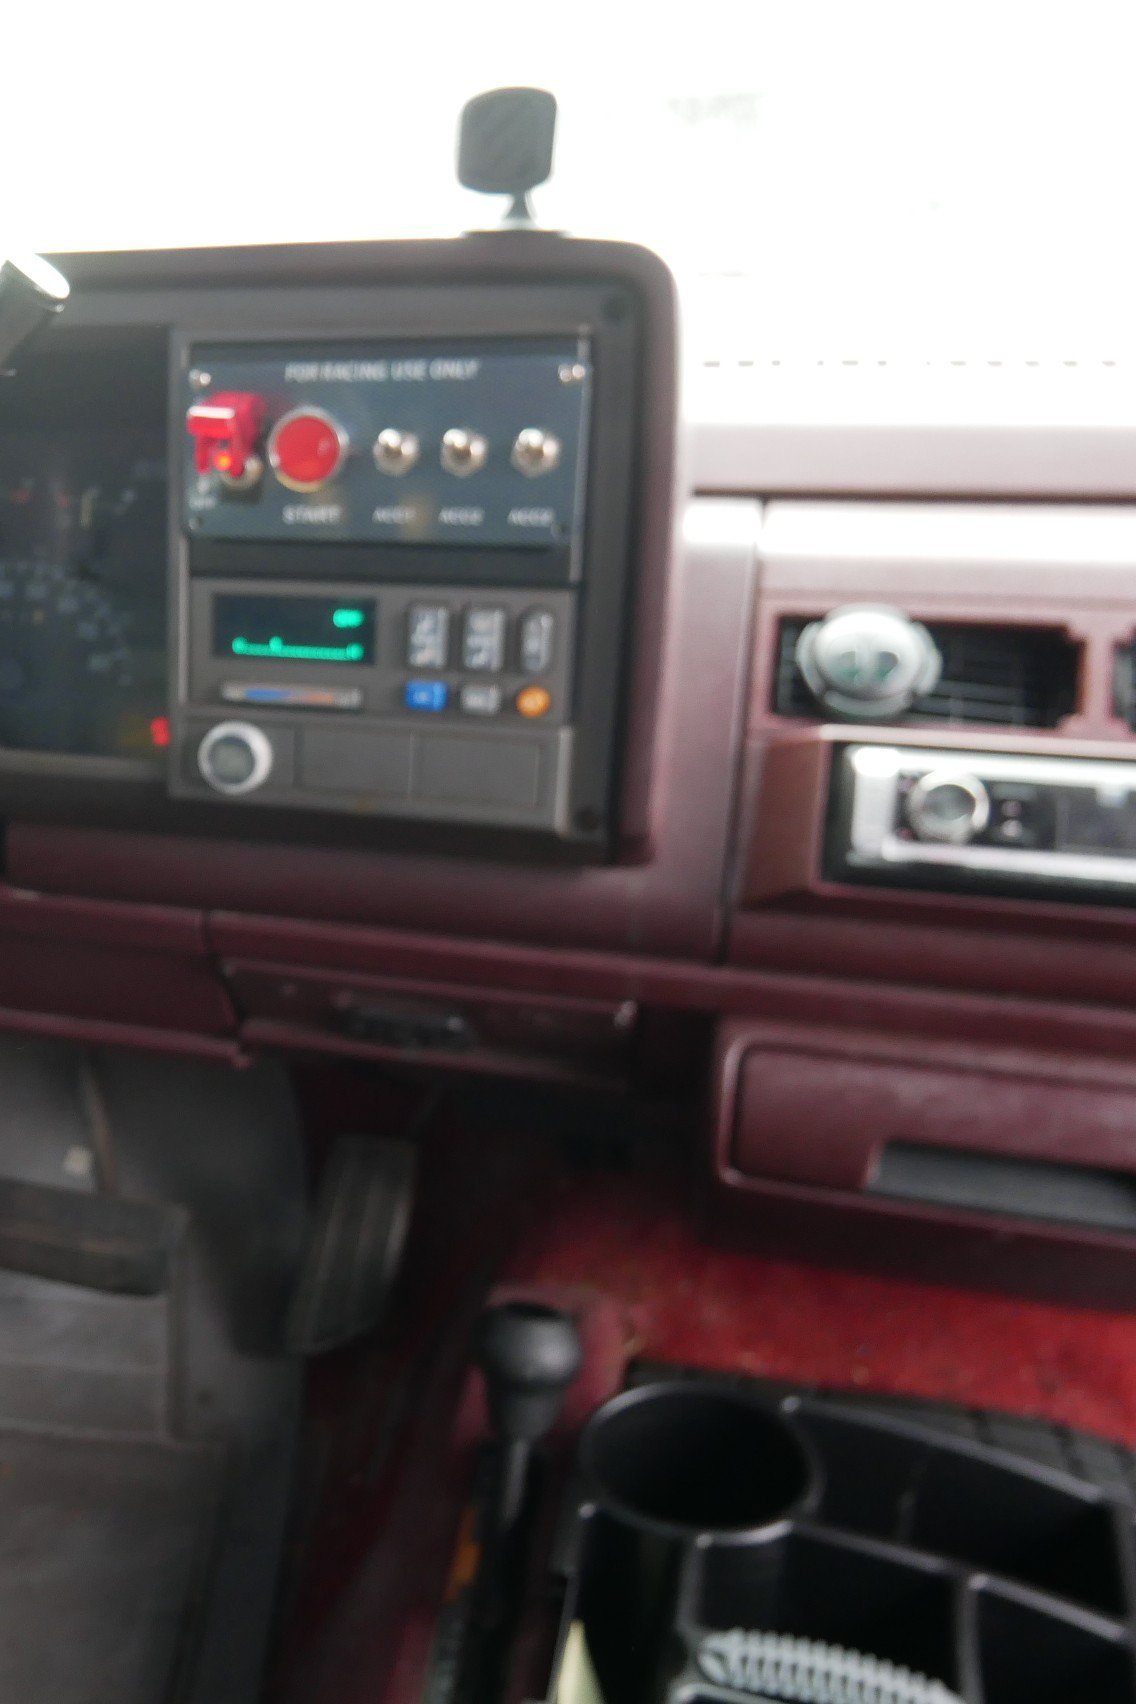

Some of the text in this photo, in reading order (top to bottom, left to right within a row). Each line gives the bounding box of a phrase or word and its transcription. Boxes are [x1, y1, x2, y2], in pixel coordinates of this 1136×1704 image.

[284, 357, 481, 382] FOR RACING USE ONLY
[282, 504, 342, 525] START
